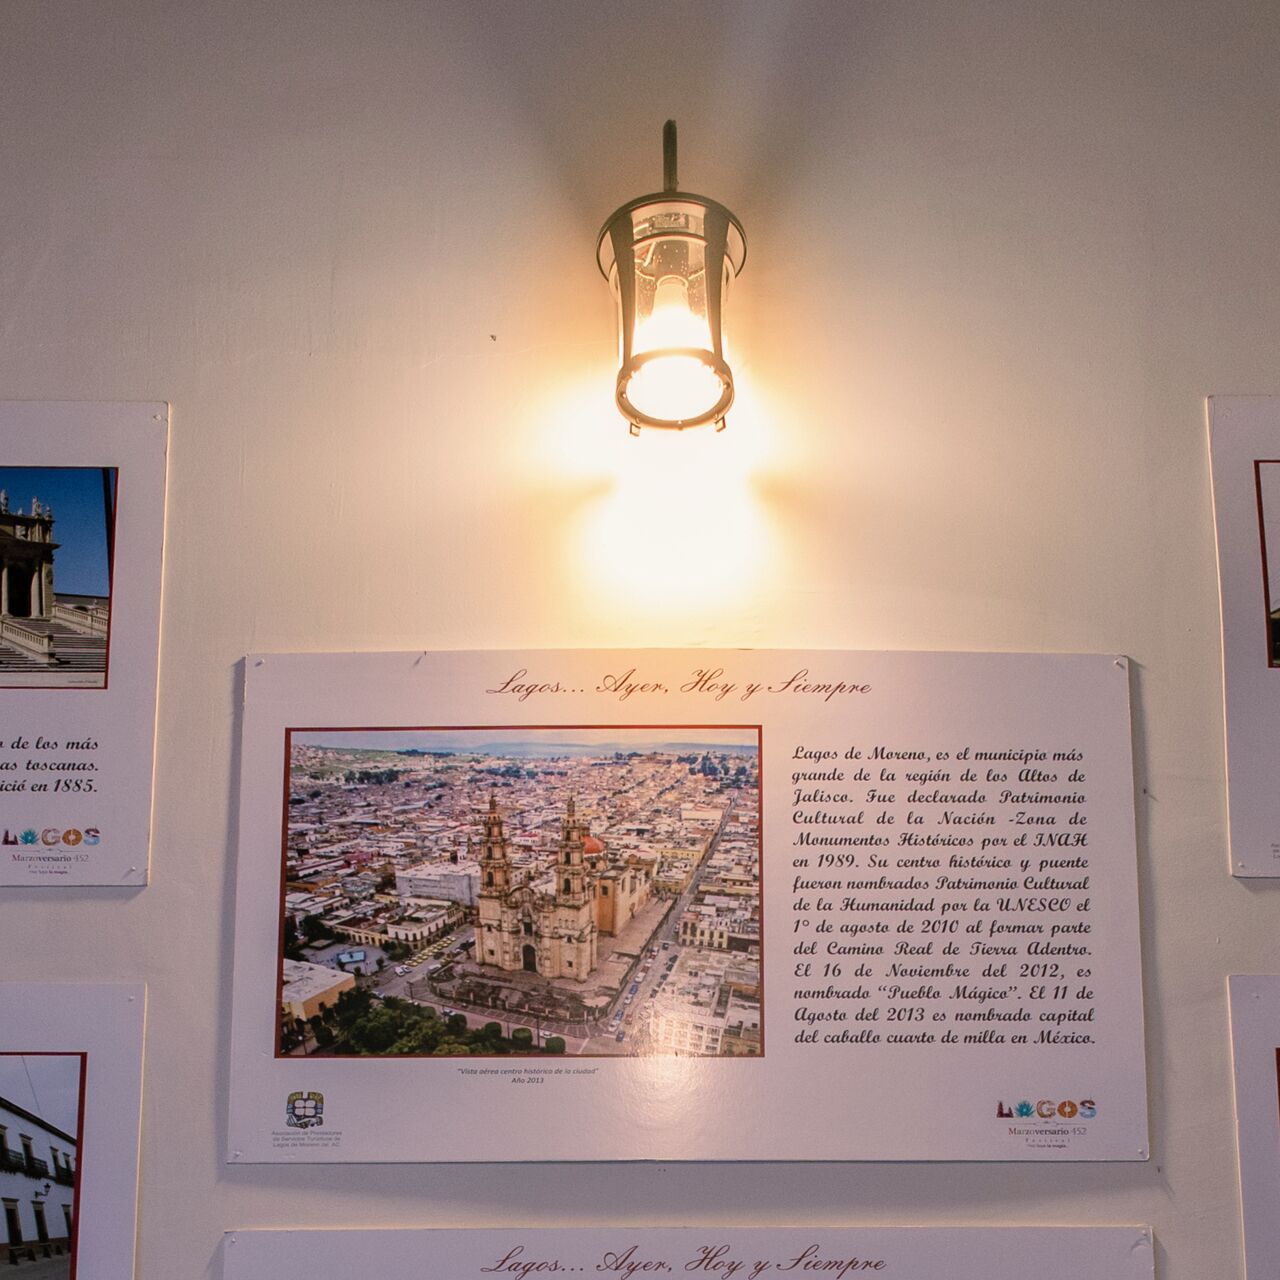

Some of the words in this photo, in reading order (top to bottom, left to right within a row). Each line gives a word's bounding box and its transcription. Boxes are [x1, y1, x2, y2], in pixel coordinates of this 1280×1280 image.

[485, 669, 584, 702] Lagos...
[595, 668, 668, 701] Ayer,
[680, 668, 737, 701] Hoy
[740, 683, 763, 702] y
[768, 669, 872, 702] Siempre
[792, 746, 838, 763] Lagos
[844, 746, 861, 760] de
[867, 746, 931, 762] Moreno,
[936, 752, 950, 760] es
[956, 747, 970, 760] el
[975, 749, 1047, 765] municipio
[1052, 748, 1083, 761] más
[30, 783, 48, 792] en
[53, 779, 97, 792] 1885.
[793, 832, 890, 846] Monumentos
[897, 832, 974, 846] Históricos
[981, 838, 1007, 850] por
[1013, 833, 1027, 846] el
[1033, 833, 1088, 847] INAH
[12, 854, 72, 862] Marzoversario
[1008, 1127, 1070, 1136] Marzoversario
[480, 1245, 584, 1280] Lagos...
[596, 1245, 672, 1280] Ayer,
[684, 1244, 745, 1280] Hoy
[748, 1260, 772, 1280] y
[776, 1244, 887, 1280] Siempre
